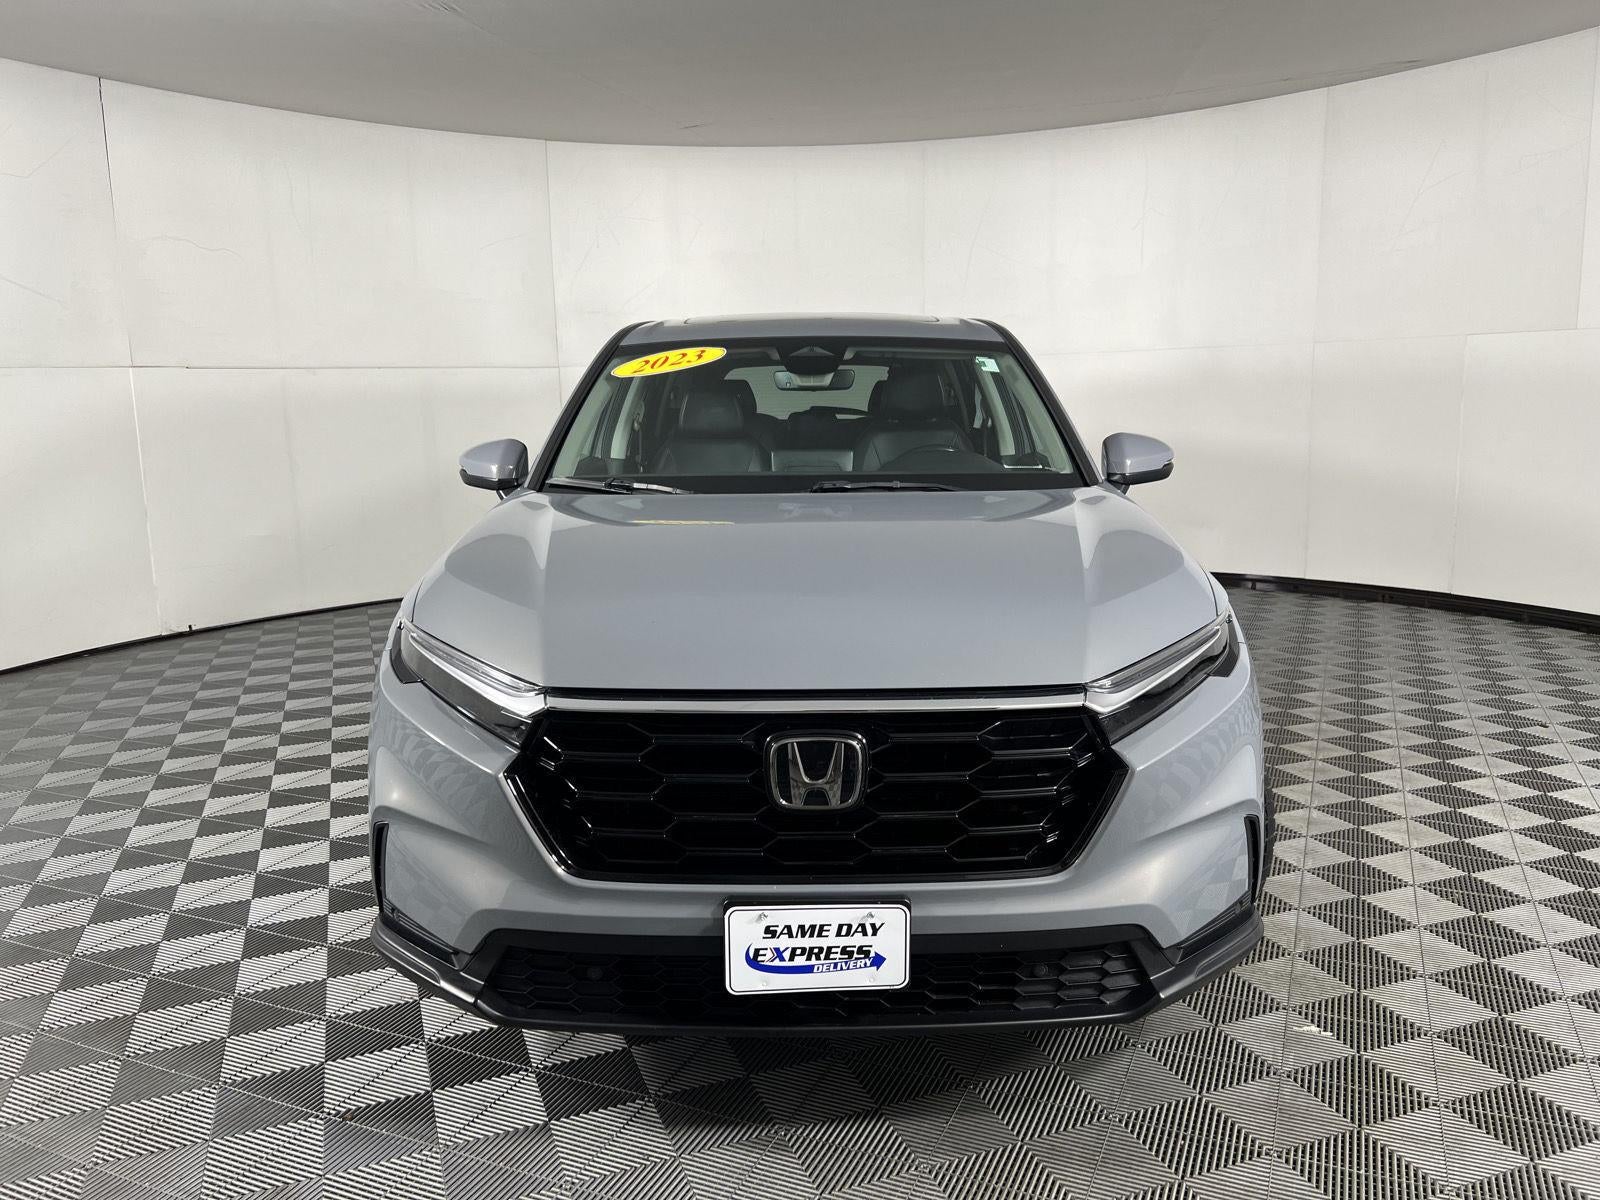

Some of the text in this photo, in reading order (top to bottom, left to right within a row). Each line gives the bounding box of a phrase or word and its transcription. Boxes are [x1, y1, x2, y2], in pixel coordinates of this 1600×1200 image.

[631, 350, 706, 374] 2023
[762, 922, 885, 939] SAME DAY
[751, 944, 873, 962] EXPRESS
[812, 957, 874, 973] DELIVERY
